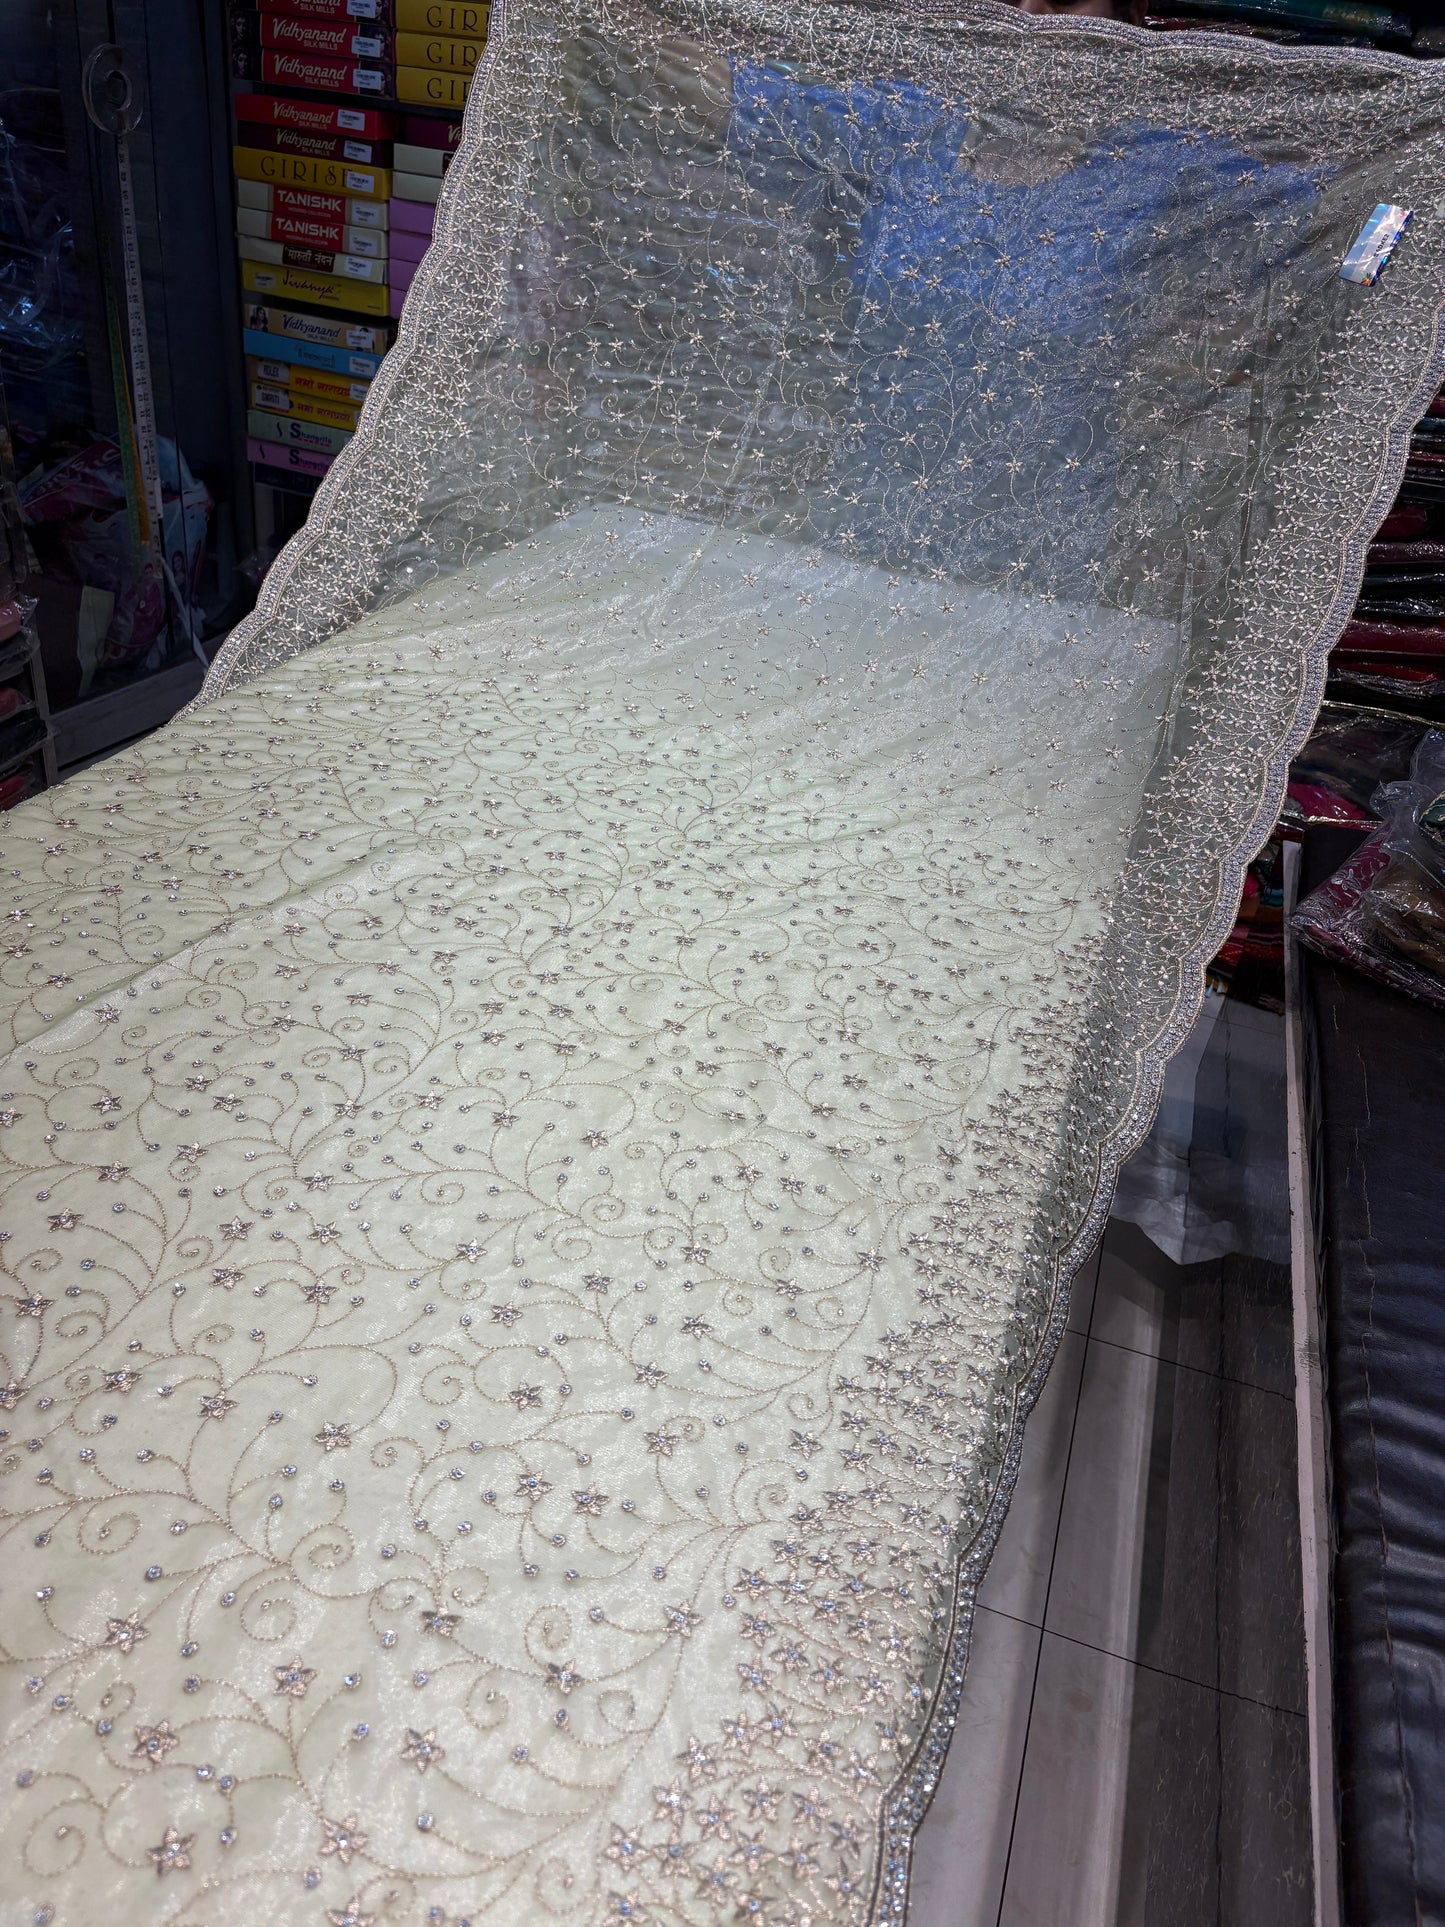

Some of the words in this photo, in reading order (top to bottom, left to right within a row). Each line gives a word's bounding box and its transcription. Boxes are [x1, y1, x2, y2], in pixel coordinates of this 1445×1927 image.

[316, 6, 335, 14] MILLS
[272, 18, 347, 43] Vidhyanand
[303, 40, 318, 48] SILK
[319, 42, 338, 50] MILLS
[273, 54, 348, 80] Vidhyanand
[305, 76, 319, 85] SILK
[320, 78, 339, 87] MILLS
[273, 101, 334, 123] Vidhyanand
[276, 128, 336, 150] Vidhyanand
[277, 190, 342, 212] TANISHK
[275, 217, 340, 240] TANISHK
[282, 314, 341, 338] Vidhyanand
